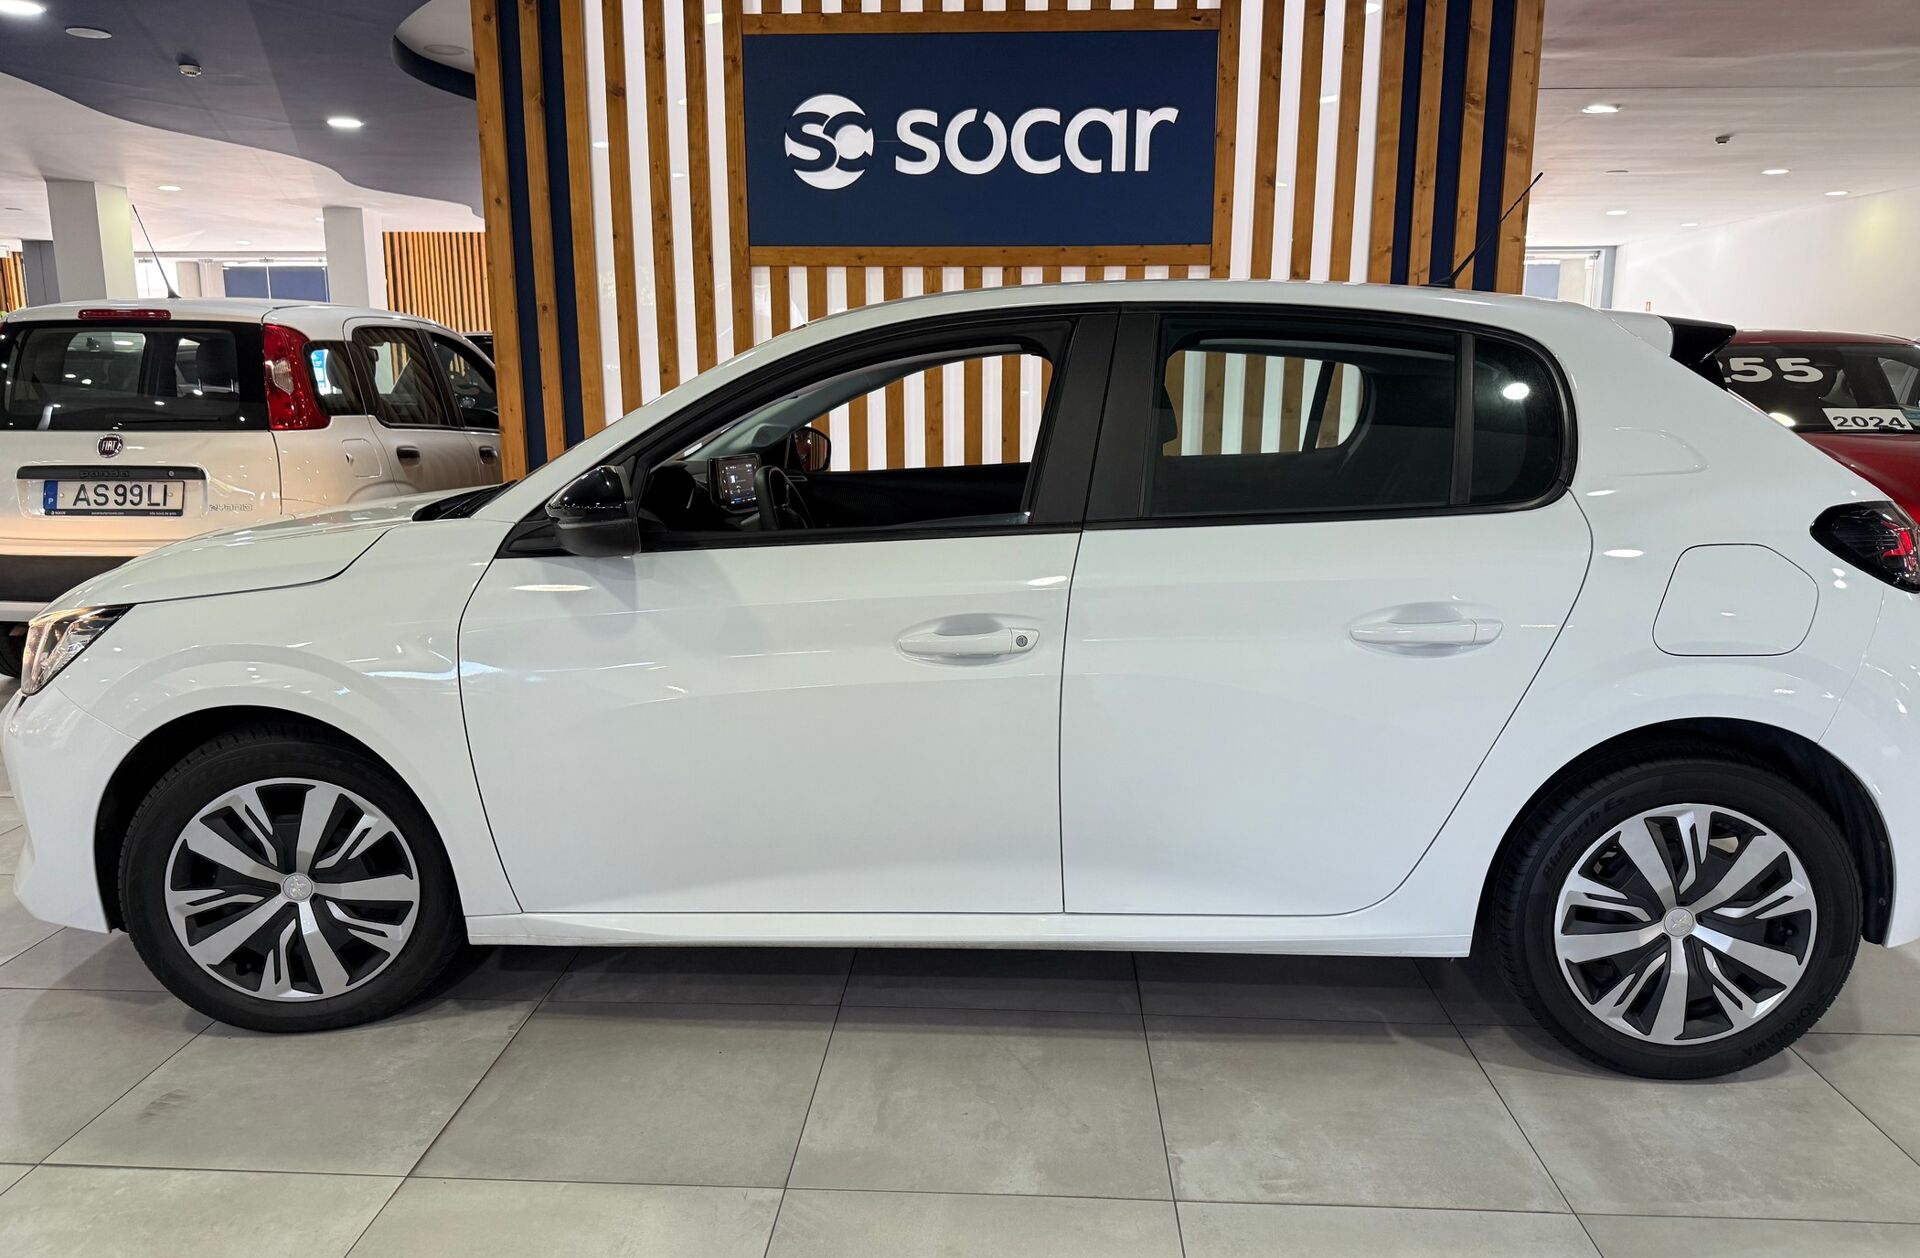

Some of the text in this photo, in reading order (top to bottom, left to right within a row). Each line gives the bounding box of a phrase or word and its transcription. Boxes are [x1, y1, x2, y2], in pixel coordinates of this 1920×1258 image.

[895, 107, 1179, 175] socar
[1717, 357, 1824, 383] 55
[1832, 416, 1906, 429] 2024
[102, 440, 117, 451] FIAT
[48, 497, 54, 505] P
[1742, 1001, 1818, 1056] YOKOHAMA
